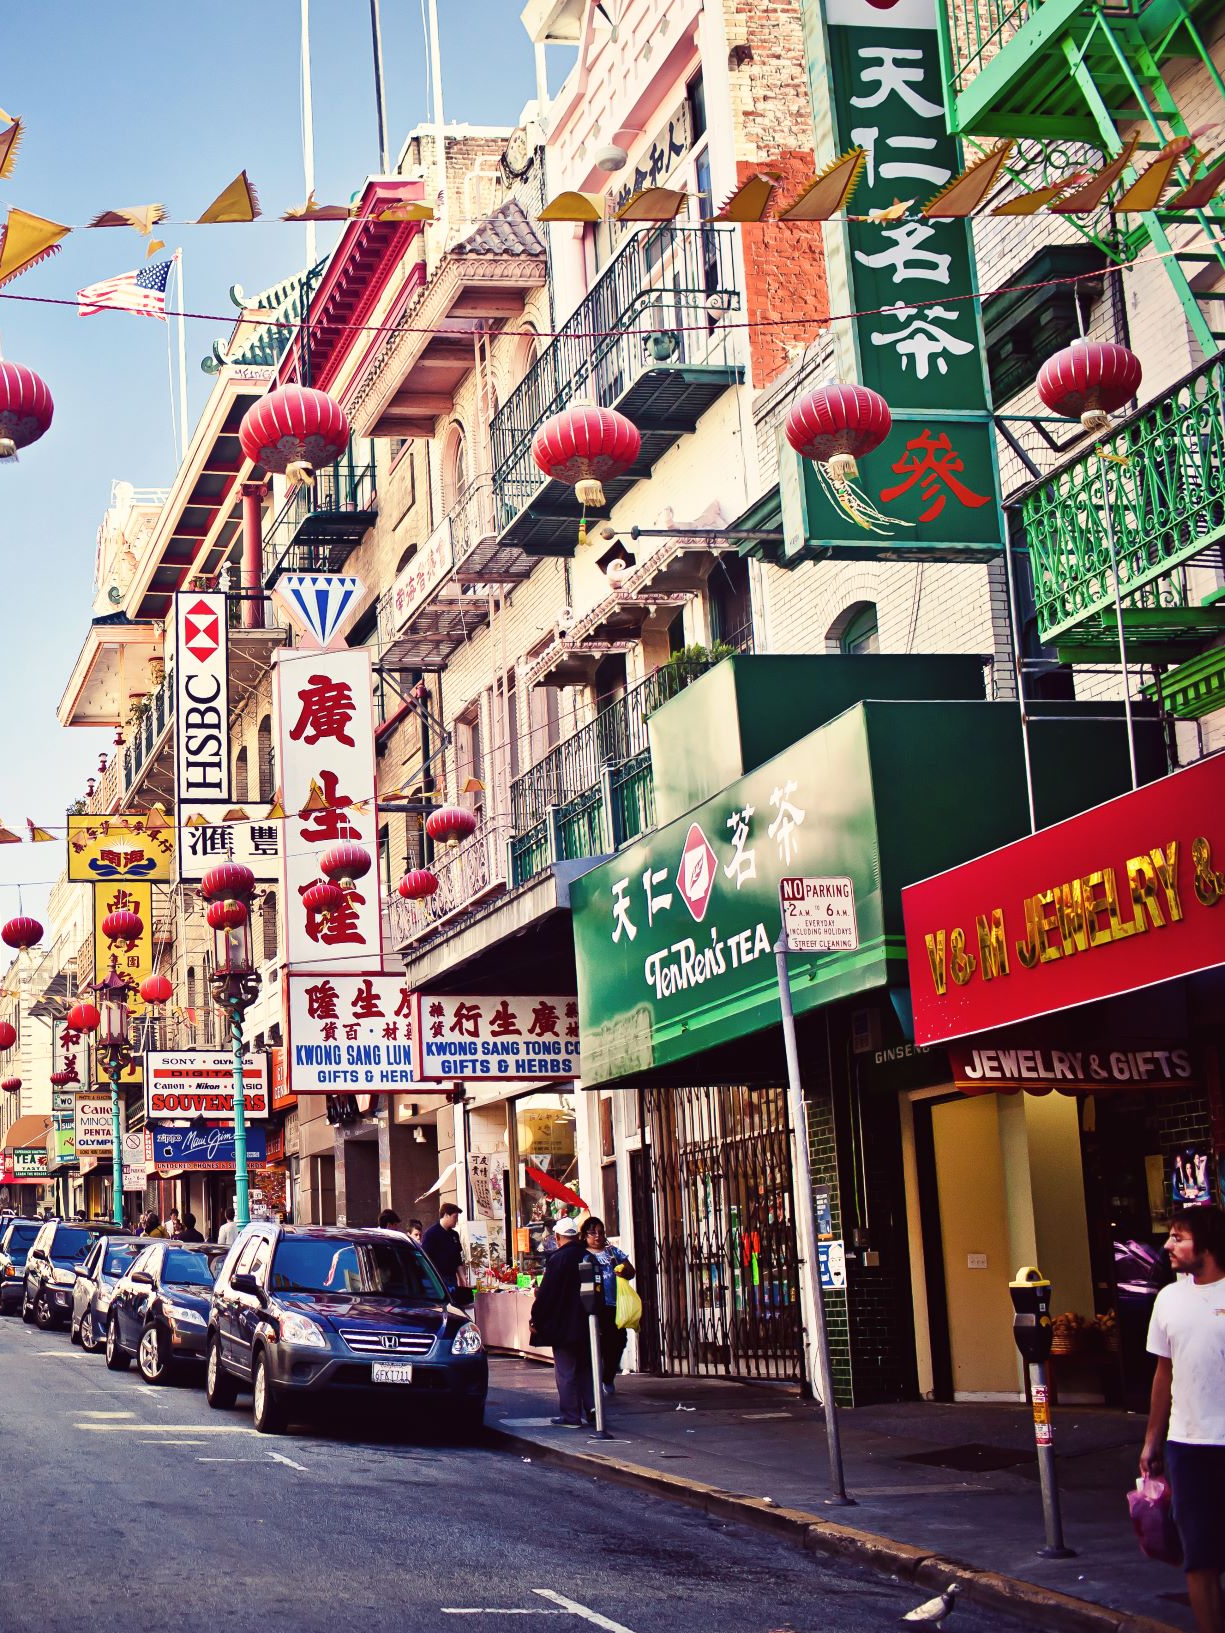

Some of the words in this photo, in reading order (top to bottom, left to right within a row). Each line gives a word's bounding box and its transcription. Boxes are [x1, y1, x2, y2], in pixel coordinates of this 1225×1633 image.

[849, 46, 975, 380] 天仁茗茶
[185, 673, 223, 793] HSBC
[611, 867, 673, 944] 天仁
[724, 779, 805, 890] 茗茶
[783, 880, 803, 898] NO
[806, 884, 849, 898] PARKING
[789, 903, 797, 917] 2
[826, 903, 834, 917] 6
[924, 929, 946, 995] V
[950, 927, 976, 985] &
[975, 908, 1010, 981] M
[1015, 840, 1183, 968] JEWELRY
[1191, 836, 1225, 906] &
[727, 922, 771, 969] TEA
[794, 940, 817, 948] STREET
[819, 940, 852, 948] CLEANING
[296, 1044, 341, 1066] KWONG
[346, 1044, 381, 1066] SANG
[425, 1041, 477, 1057] KWONG
[481, 1041, 520, 1056] SANG
[520, 1041, 562, 1056] TONG
[441, 1058, 490, 1075] GIFTS
[497, 1058, 509, 1074] &
[515, 1058, 572, 1074] HERBS
[964, 1049, 1085, 1080] JEWELRY
[1089, 1053, 1110, 1079] &
[1109, 1049, 1192, 1080] GIFTS
[317, 1070, 358, 1083] GIFTS
[365, 1070, 374, 1083] &
[154, 1082, 185, 1090] Canon
[195, 1082, 220, 1090] Nikon
[81, 1104, 116, 1115] Cano
[152, 1093, 266, 1111] SOUVENRS
[84, 1128, 113, 1136] PENTA
[14, 1153, 36, 1164] TEA
